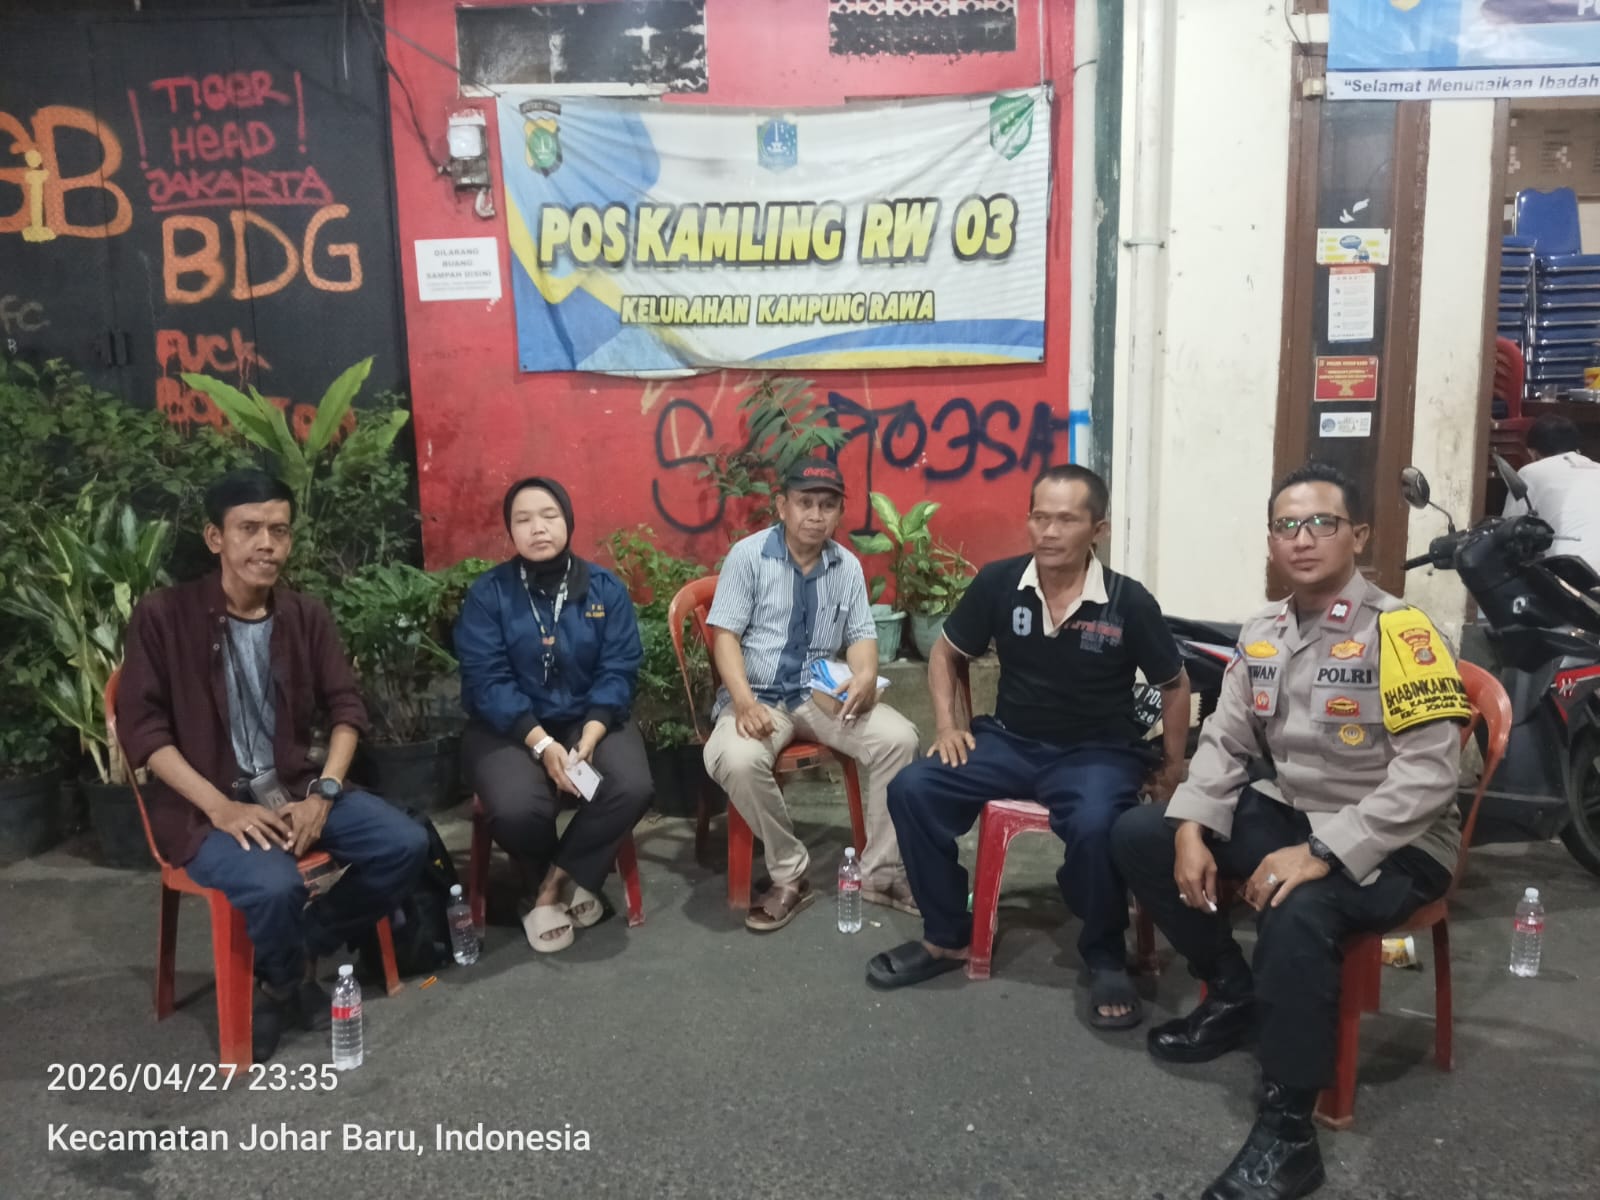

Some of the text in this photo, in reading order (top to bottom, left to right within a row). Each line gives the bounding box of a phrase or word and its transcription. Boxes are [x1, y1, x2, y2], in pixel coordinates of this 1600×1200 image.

[1427, 78, 1533, 92] Menunaikan
[1539, 74, 1599, 90] Ibadah
[145, 165, 335, 205] JAKARTA
[539, 193, 1019, 267] POS KAMLING RW 03
[162, 203, 363, 304] BDG
[433, 247, 479, 257] DILARANG
[442, 259, 473, 268] BUANG
[426, 271, 492, 280] SAMPAH DISINI
[620, 289, 936, 325] KELURAHAN KAMPUNG RAWA
[1317, 667, 1373, 684] POLRI
